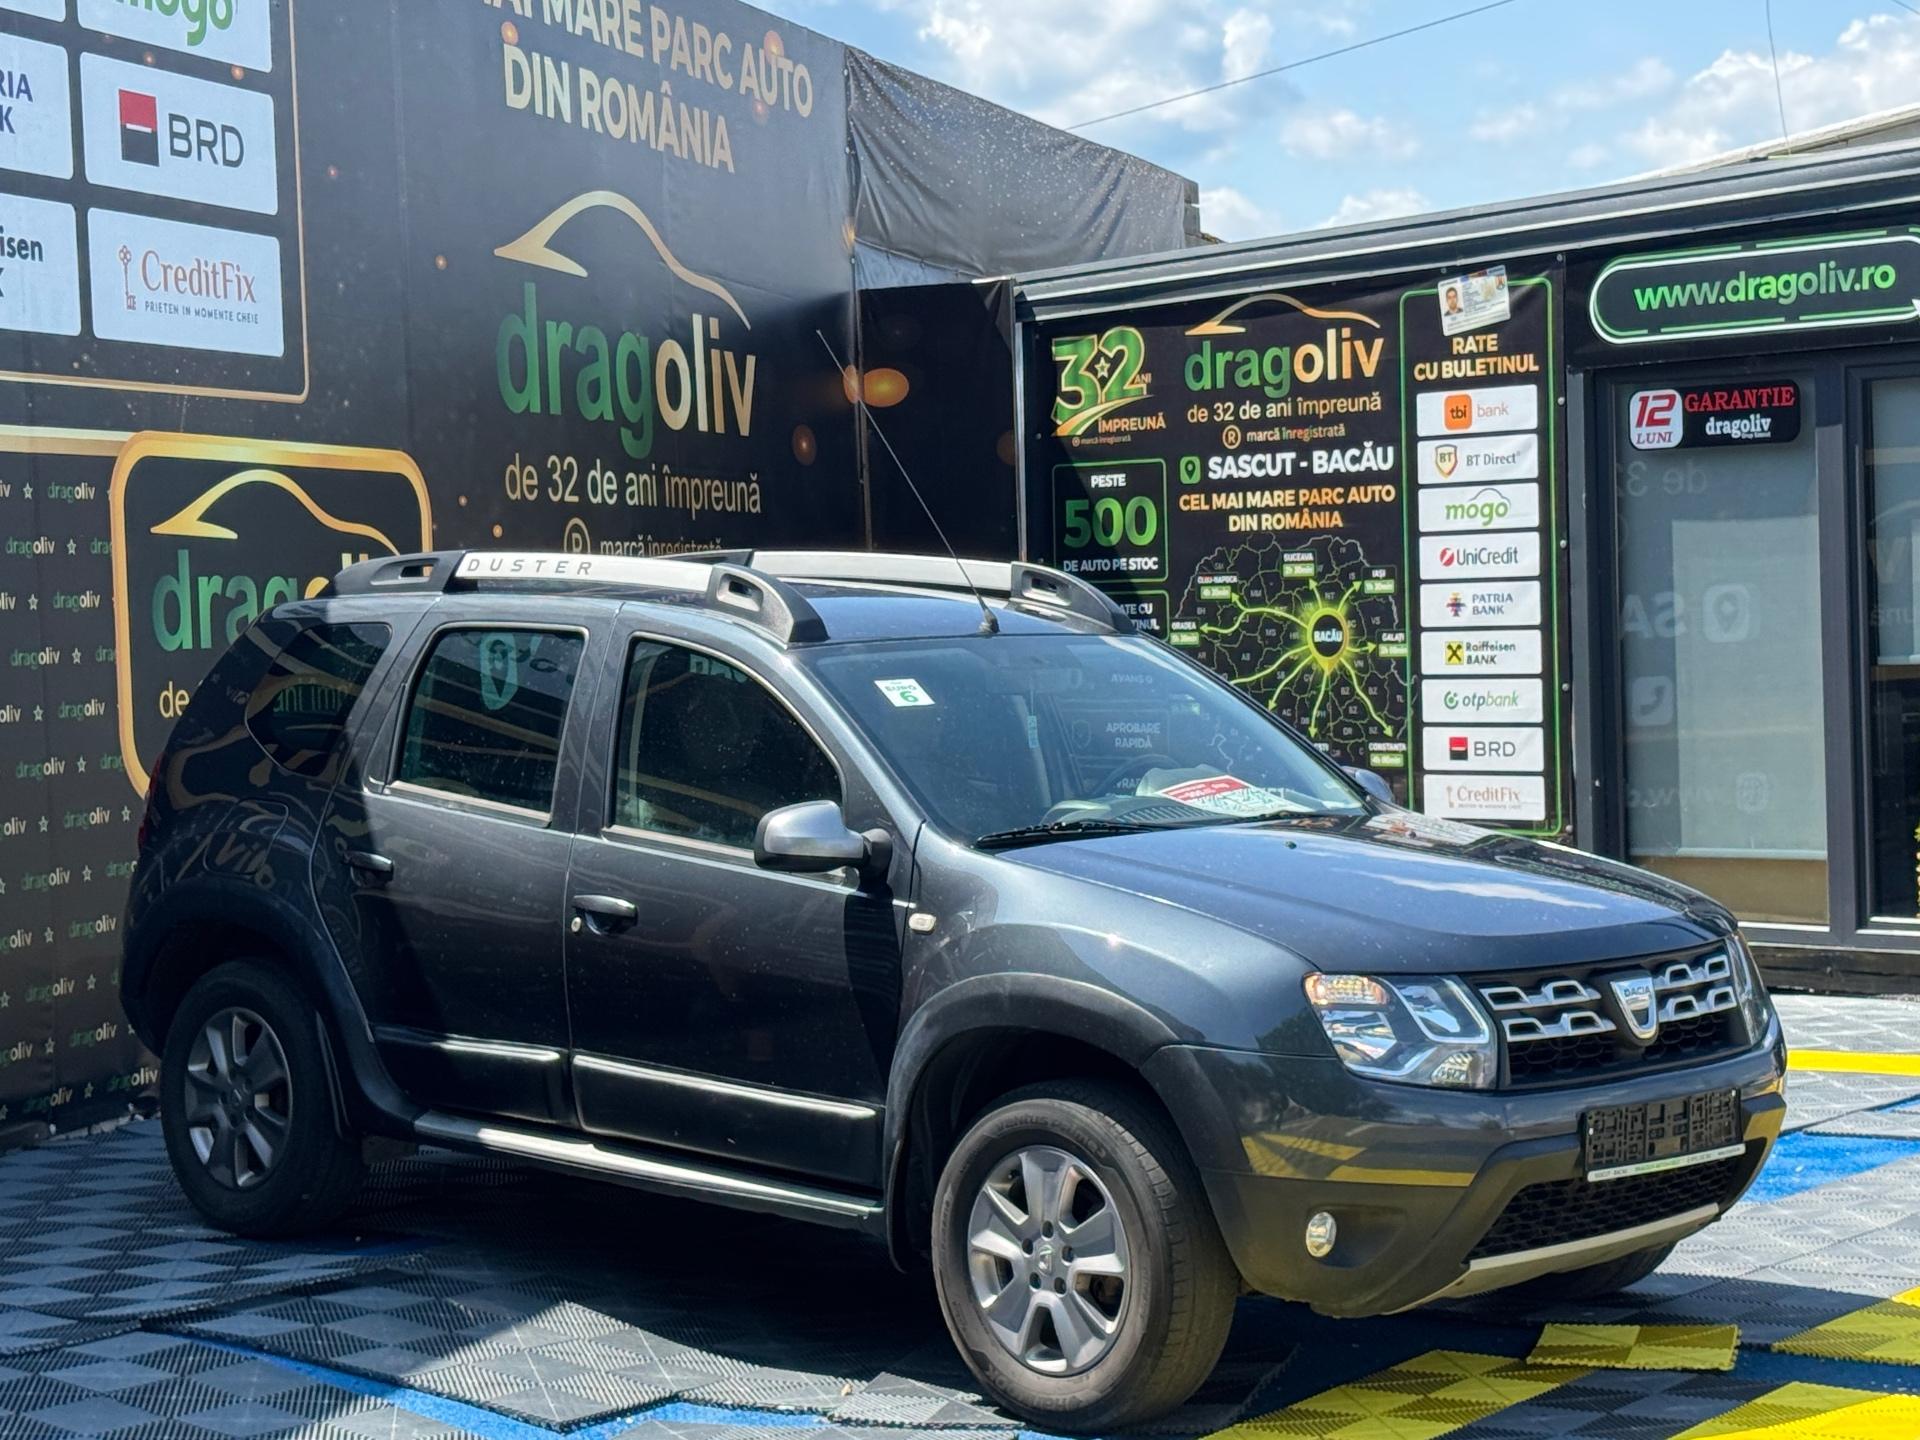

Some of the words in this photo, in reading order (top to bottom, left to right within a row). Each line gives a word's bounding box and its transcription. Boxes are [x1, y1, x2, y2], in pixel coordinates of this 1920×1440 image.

[650, 5, 734, 89] PARC
[740, 43, 814, 118] AUTO
[504, 43, 572, 124] DIN
[579, 67, 736, 174] ROMÂNIA
[168, 113, 246, 169] BRD
[141, 250, 257, 304] CreditFix
[1633, 260, 1896, 312] www.dragoliv.ro
[144, 301, 180, 315] PRIETEN
[182, 306, 191, 316] IN
[194, 307, 234, 323] MOMENTE
[236, 312, 259, 325] CHEIE
[1452, 333, 1499, 355] RATE
[496, 282, 757, 459] dragoliv
[1184, 327, 1385, 399] dragoliv
[1413, 362, 1439, 381] CU
[1441, 354, 1540, 380] BULETINUL
[1187, 404, 1209, 424] de
[1213, 401, 1235, 422] 32
[1239, 400, 1261, 421] de
[1266, 397, 1292, 419] ani
[1296, 391, 1382, 420] împreună
[1450, 405, 1467, 420] tbi
[1477, 403, 1510, 418] bank
[1636, 393, 1677, 429] 12
[1684, 386, 1796, 413] GARANTIE
[1246, 425, 1281, 442] marcă
[1281, 423, 1346, 442] înregistrată
[1705, 413, 1772, 439] dragoliv
[1636, 432, 1673, 445] LUNI
[1207, 452, 1297, 480] SASCUT
[1312, 442, 1395, 475] BACĂU
[1466, 454, 1481, 467] BT
[47, 480, 96, 504] dragoliv
[505, 453, 539, 502] de
[547, 454, 580, 503] 32
[587, 458, 618, 505] de
[625, 463, 658, 507] ani
[663, 464, 762, 520] împreună
[1090, 473, 1127, 489] PESTE
[1179, 493, 1210, 512] CEL
[1211, 491, 1244, 510] MAI
[1246, 488, 1297, 509] MARE
[1298, 486, 1345, 507] PARC
[1346, 484, 1396, 504] AUTO
[1063, 496, 1158, 548] 500
[1228, 513, 1262, 532] DIN
[1263, 508, 1343, 531] ROMÂNIA
[1445, 500, 1509, 527] mogo
[5, 535, 56, 559] dragoliv
[1457, 547, 1519, 566] UniCredit
[467, 558, 592, 576] DUSTER
[1063, 560, 1079, 572] DE
[1080, 559, 1112, 571] AUTO
[1112, 558, 1127, 570] PE
[1128, 557, 1159, 570] STOC
[53, 589, 101, 613] dragoliv
[1138, 602, 1154, 615] CU
[1472, 593, 1514, 604] PATRIA
[1472, 605, 1505, 616] BANK
[1313, 627, 1343, 643] BACĂU
[1466, 641, 1517, 653] Raiffeisen
[11, 646, 61, 671] dragoliv
[1467, 654, 1497, 665] BANK
[899, 690, 919, 703] 6
[1462, 690, 1520, 711] otpbank
[58, 698, 106, 722] dragoliv
[1106, 721, 1161, 735] APROBARE
[1114, 735, 1153, 749] RAPIDĂ
[1474, 741, 1517, 757] BRD
[16, 757, 66, 782] dragoliv
[1457, 786, 1521, 802] CreditFix
[64, 806, 111, 831] dragoliv
[22, 866, 71, 893] dragoliv
[69, 914, 117, 940] dragoliv
[1623, 986, 1650, 998] DACIA
